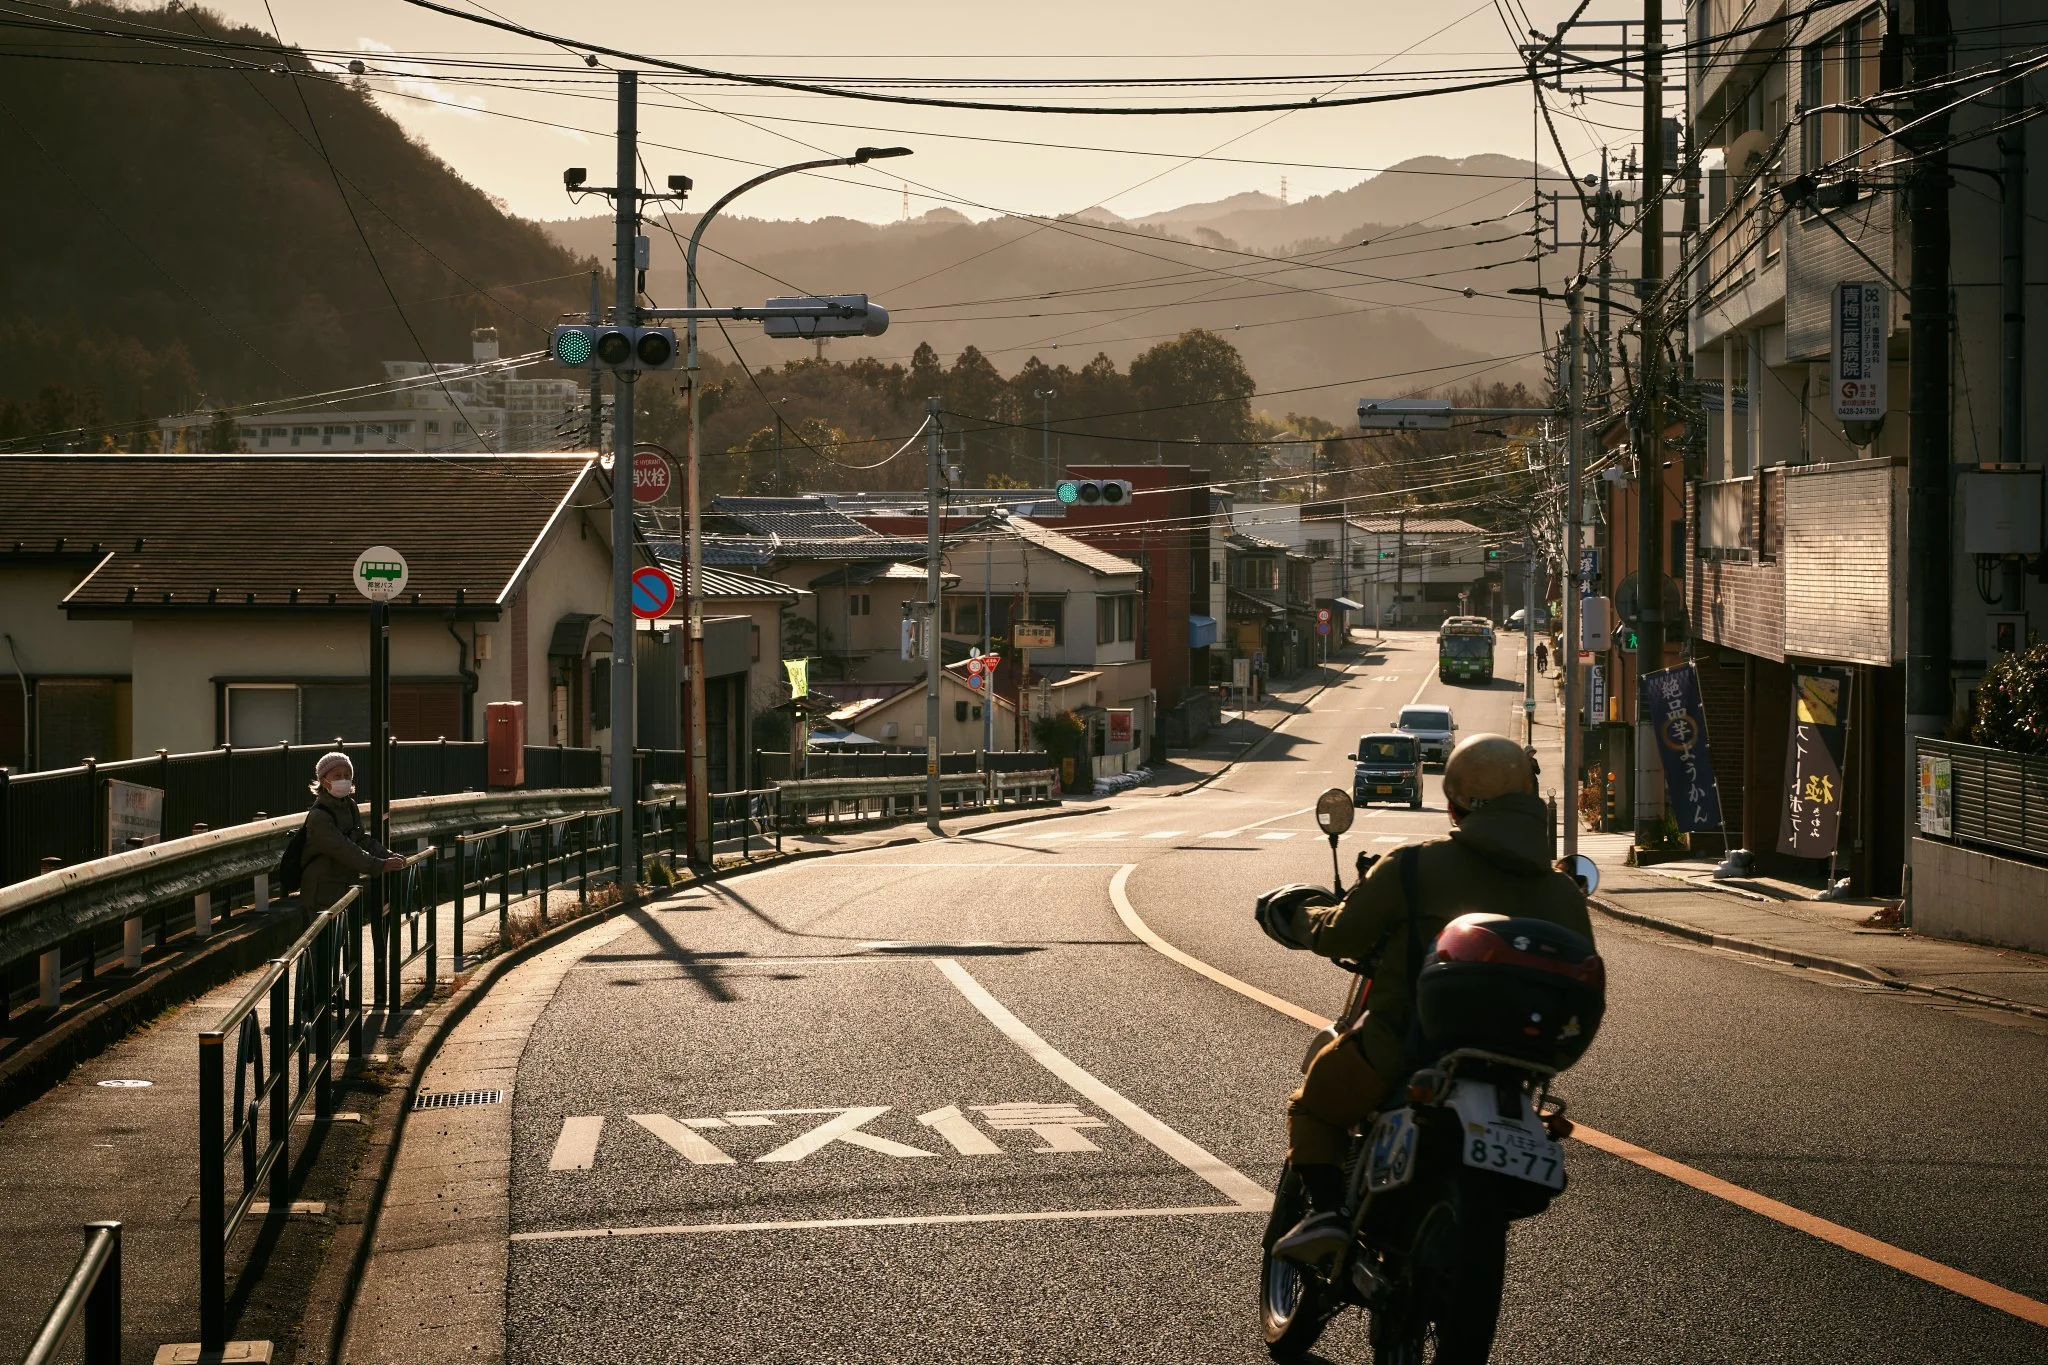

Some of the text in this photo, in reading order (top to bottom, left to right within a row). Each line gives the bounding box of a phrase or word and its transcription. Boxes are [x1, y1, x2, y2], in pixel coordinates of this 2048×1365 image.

[1843, 288, 1860, 376] 青梅三慶病院
[1863, 305, 1871, 378] リハビリテーション科
[1838, 407, 1880, 415] 0428-24-7501
[971, 662, 980, 670] 30
[1661, 679, 1708, 823] 絶品芋ようかん
[1471, 1139, 1558, 1182] 83-77
[1505, 1134, 1536, 1151] 八王子
